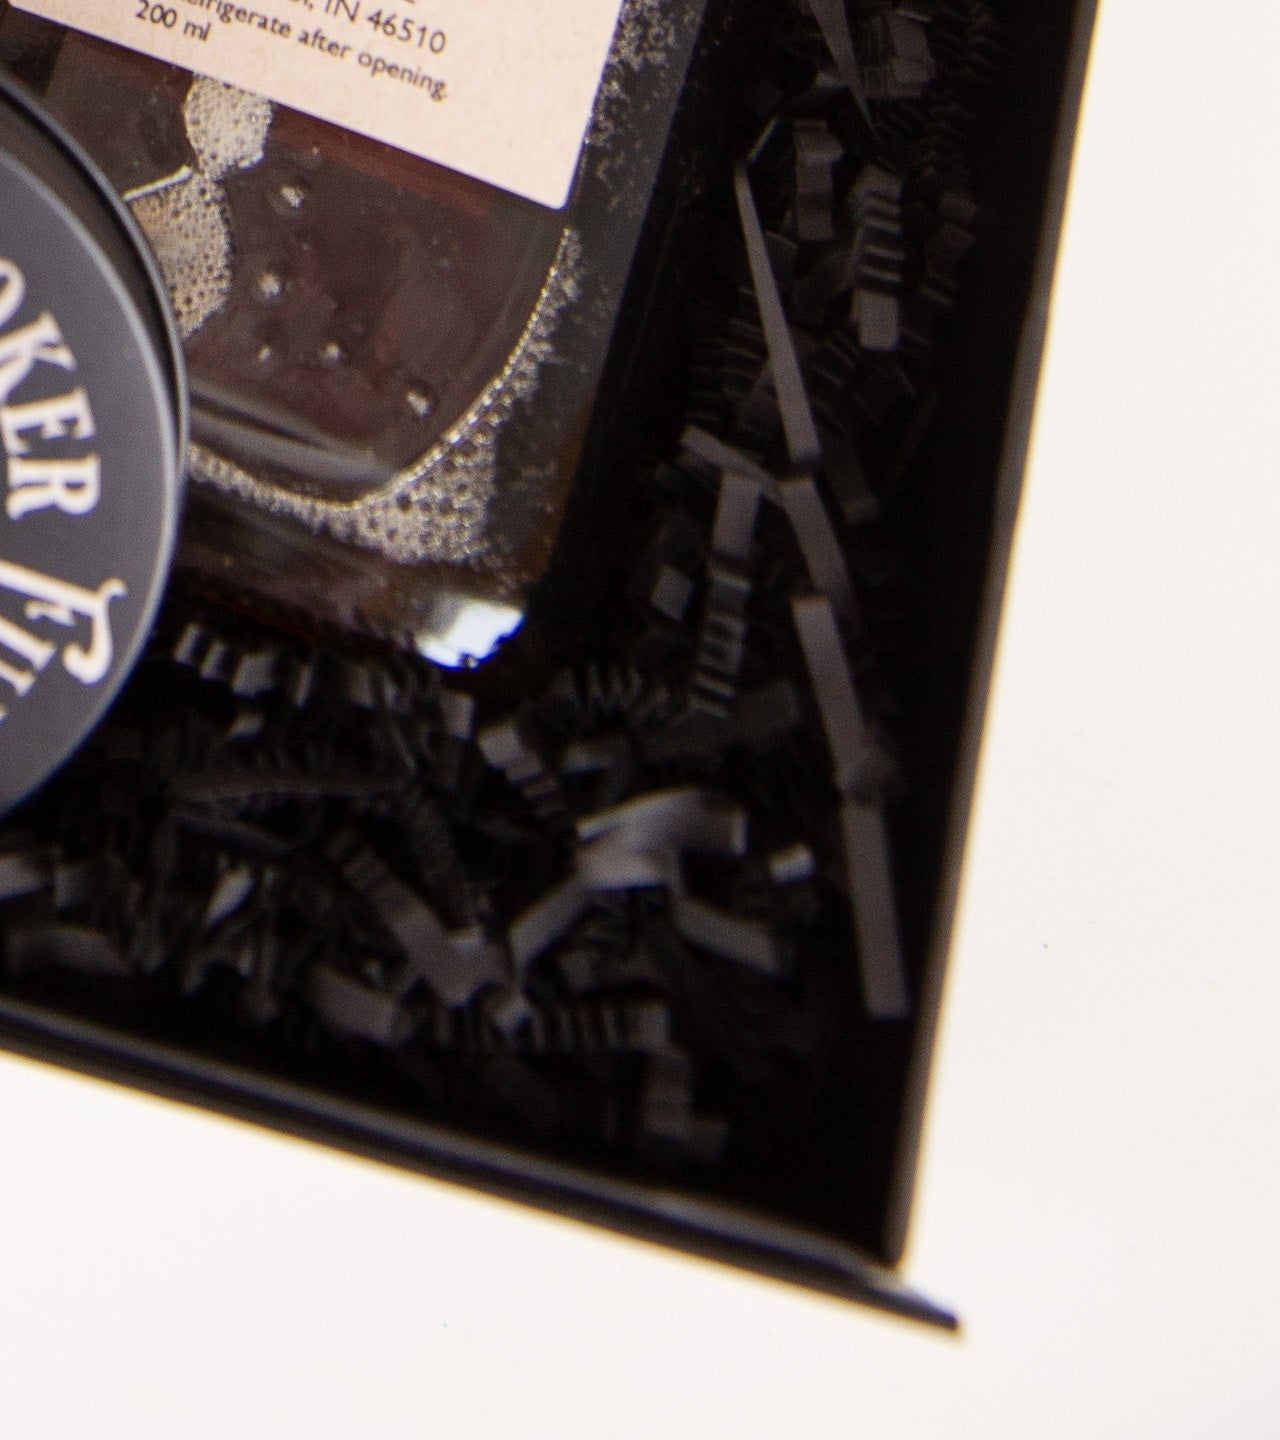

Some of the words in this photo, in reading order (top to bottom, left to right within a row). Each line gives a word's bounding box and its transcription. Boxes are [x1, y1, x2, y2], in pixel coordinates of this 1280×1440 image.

[135, 0, 176, 28] 200
[183, 17, 213, 42] ml
[298, 25, 349, 58] after
[367, 7, 447, 55] 46510
